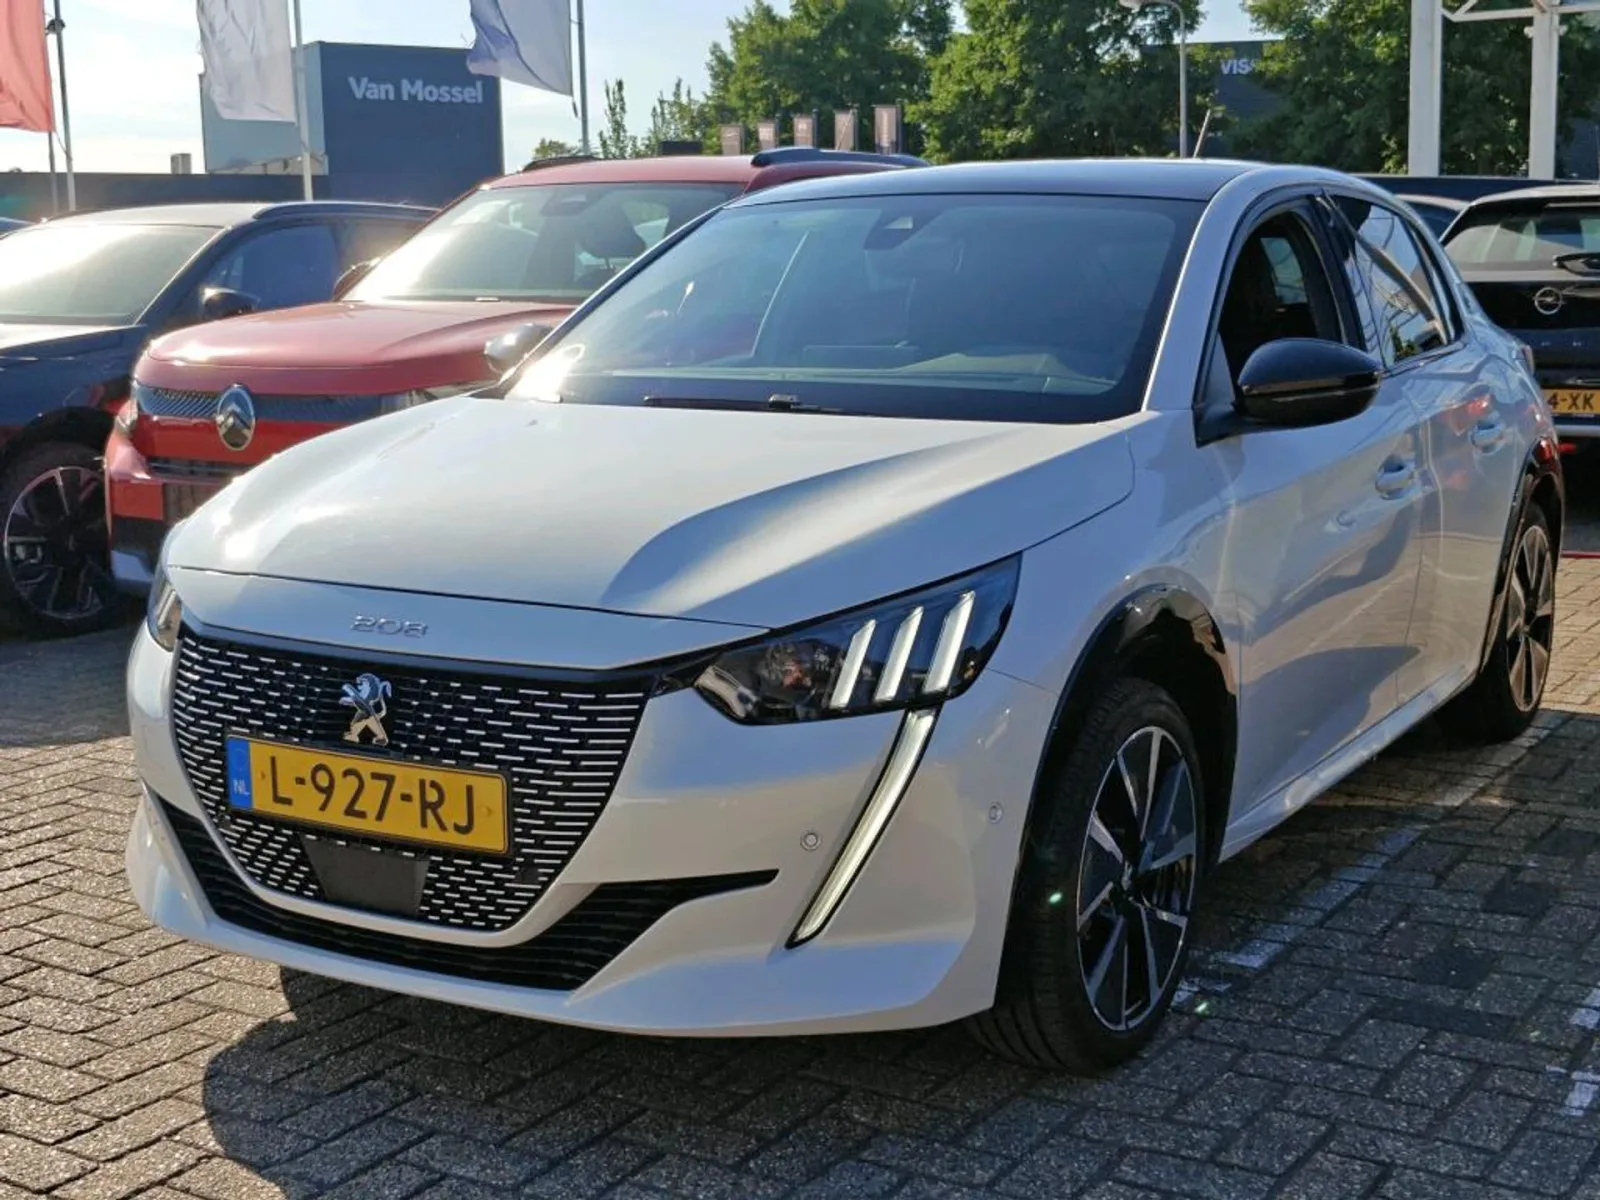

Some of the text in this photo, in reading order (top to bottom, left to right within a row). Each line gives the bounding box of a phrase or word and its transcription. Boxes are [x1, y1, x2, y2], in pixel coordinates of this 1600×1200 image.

[348, 76, 483, 104] Van Mossel
[350, 615, 428, 638] 208
[232, 777, 250, 796] NL
[269, 756, 475, 835] L-927-RJ
